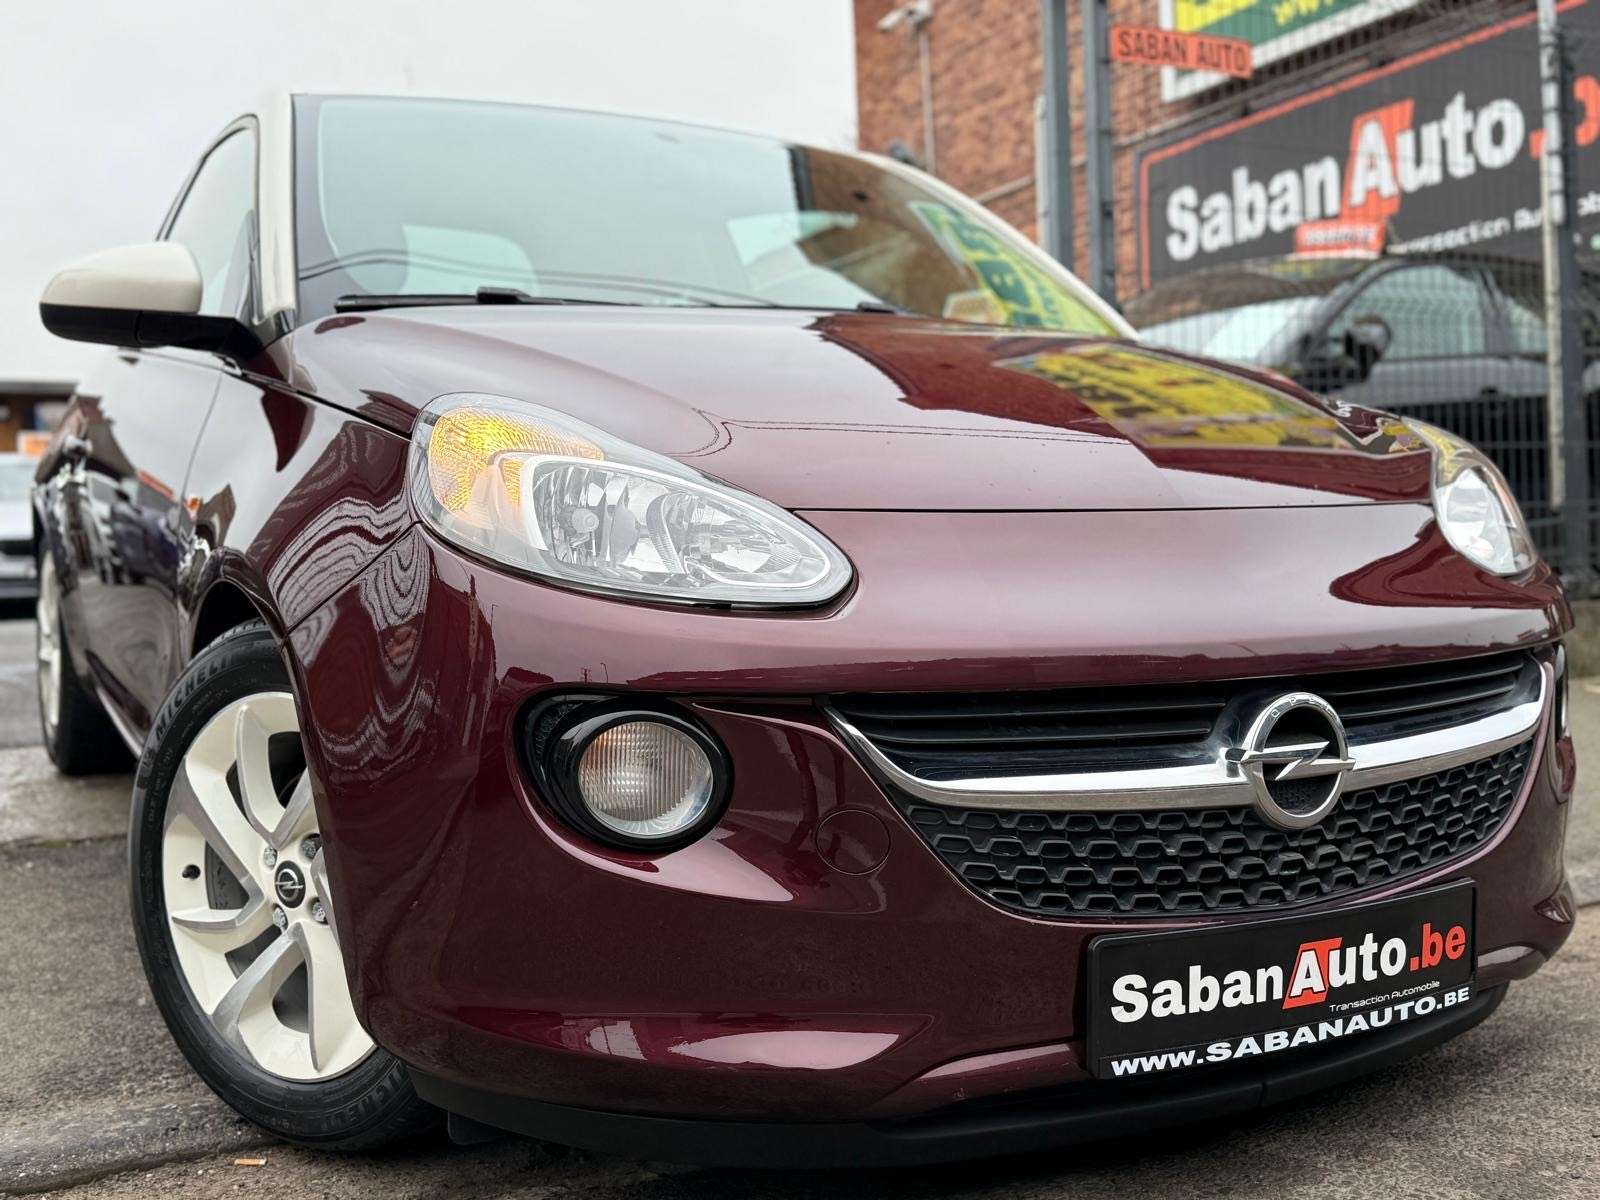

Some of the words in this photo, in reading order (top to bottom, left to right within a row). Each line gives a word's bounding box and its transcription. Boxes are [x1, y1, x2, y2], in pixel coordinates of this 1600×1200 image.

[1118, 30, 1188, 63] SABAN
[1197, 40, 1247, 71] AUTO
[1110, 922, 1466, 1023] SabanAuto.be
[1328, 994, 1391, 1013] Transaction
[1391, 980, 1441, 999] Automobile
[1110, 986, 1470, 1076] www.SABANAUTO.BE
